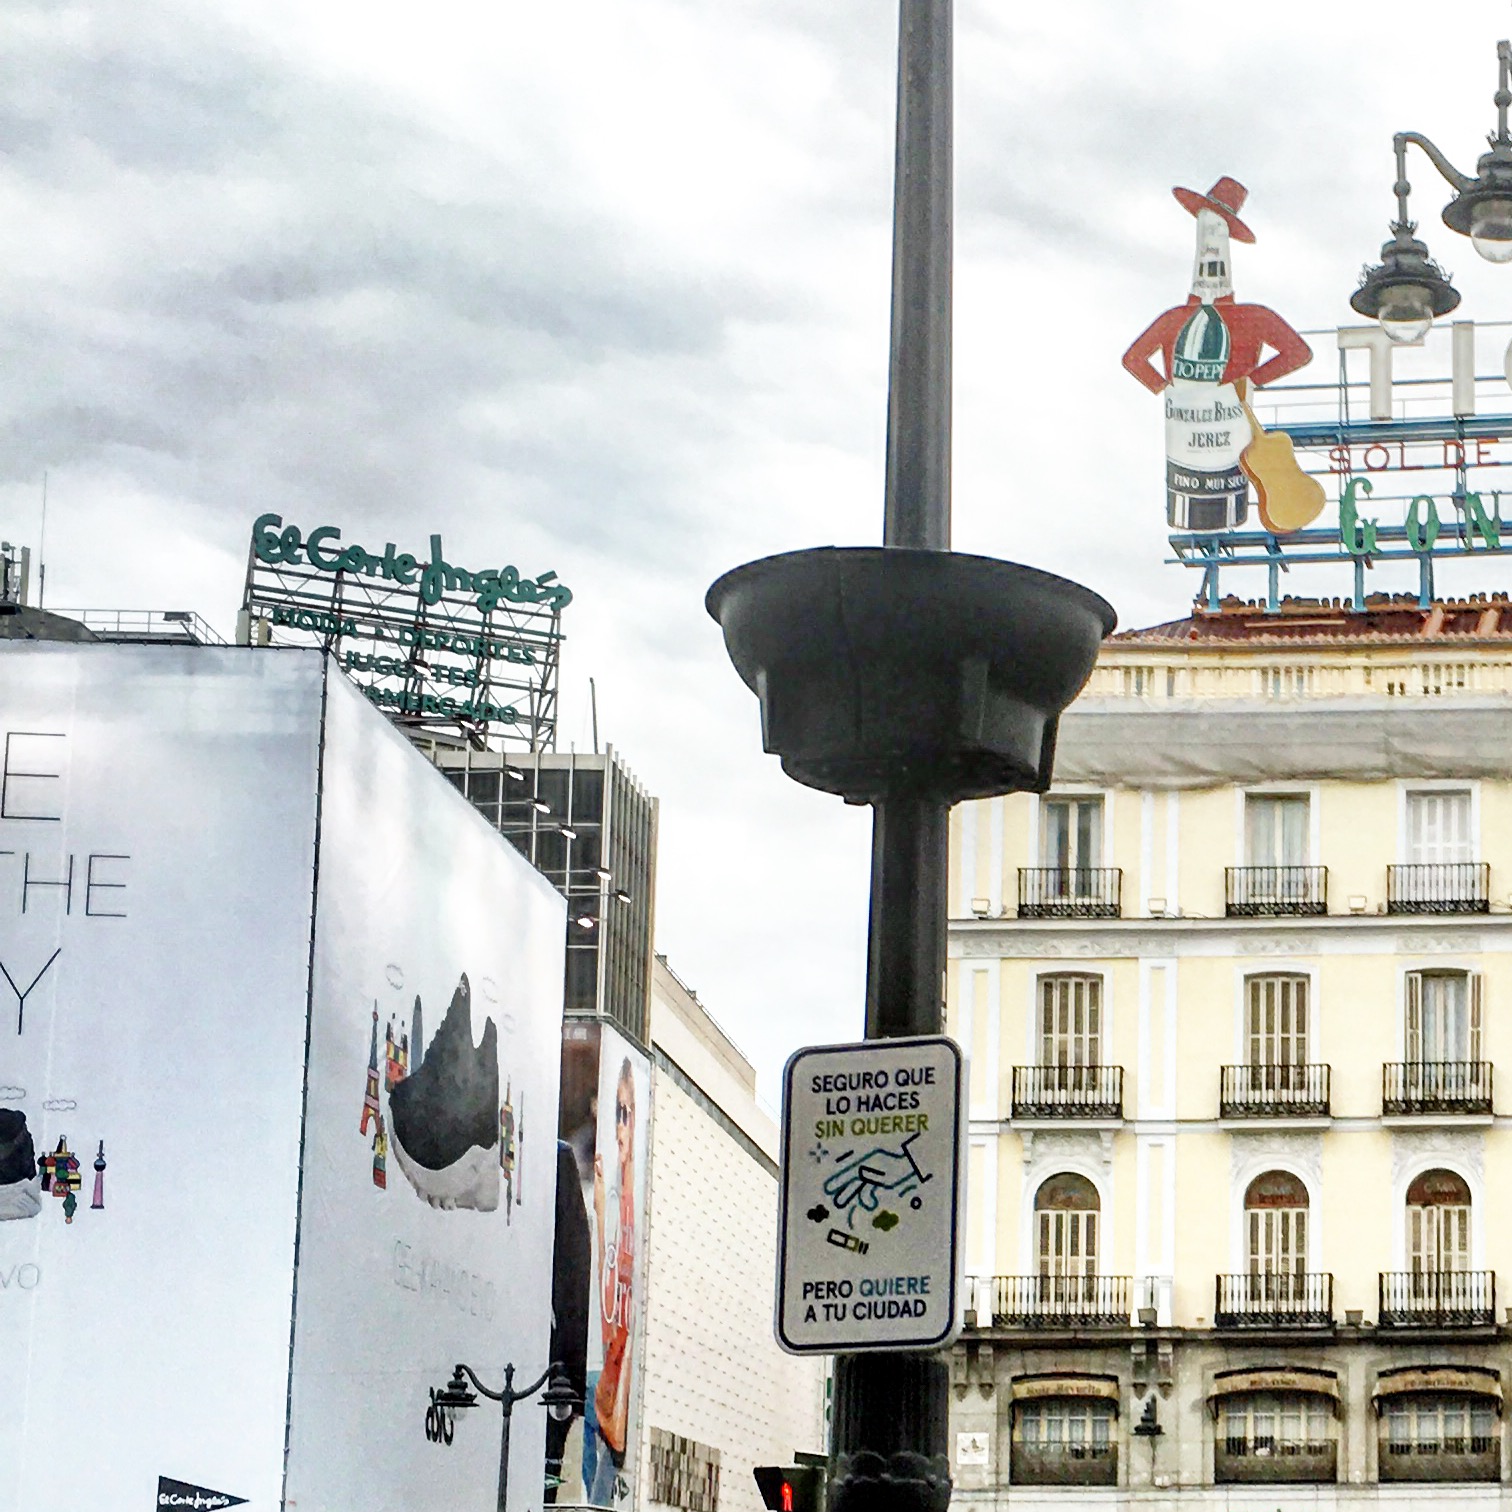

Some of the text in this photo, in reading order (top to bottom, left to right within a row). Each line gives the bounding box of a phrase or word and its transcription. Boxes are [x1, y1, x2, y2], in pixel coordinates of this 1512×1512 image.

[1188, 431, 1231, 448] JEREZ
[1329, 444, 1424, 474] SOL
[1443, 437, 1500, 468] DE
[1174, 473, 1199, 489] FINO
[253, 513, 573, 613] El Corte Inglés
[272, 605, 536, 666] MODA DEPORTES
[811, 1067, 936, 1094] SEGURO QUE
[826, 1092, 920, 1116] LO HACES
[814, 1114, 930, 1139] SIN QUERER
[802, 1276, 932, 1300] PERO QUIERE
[804, 1299, 928, 1323] A TU CIUDAD
